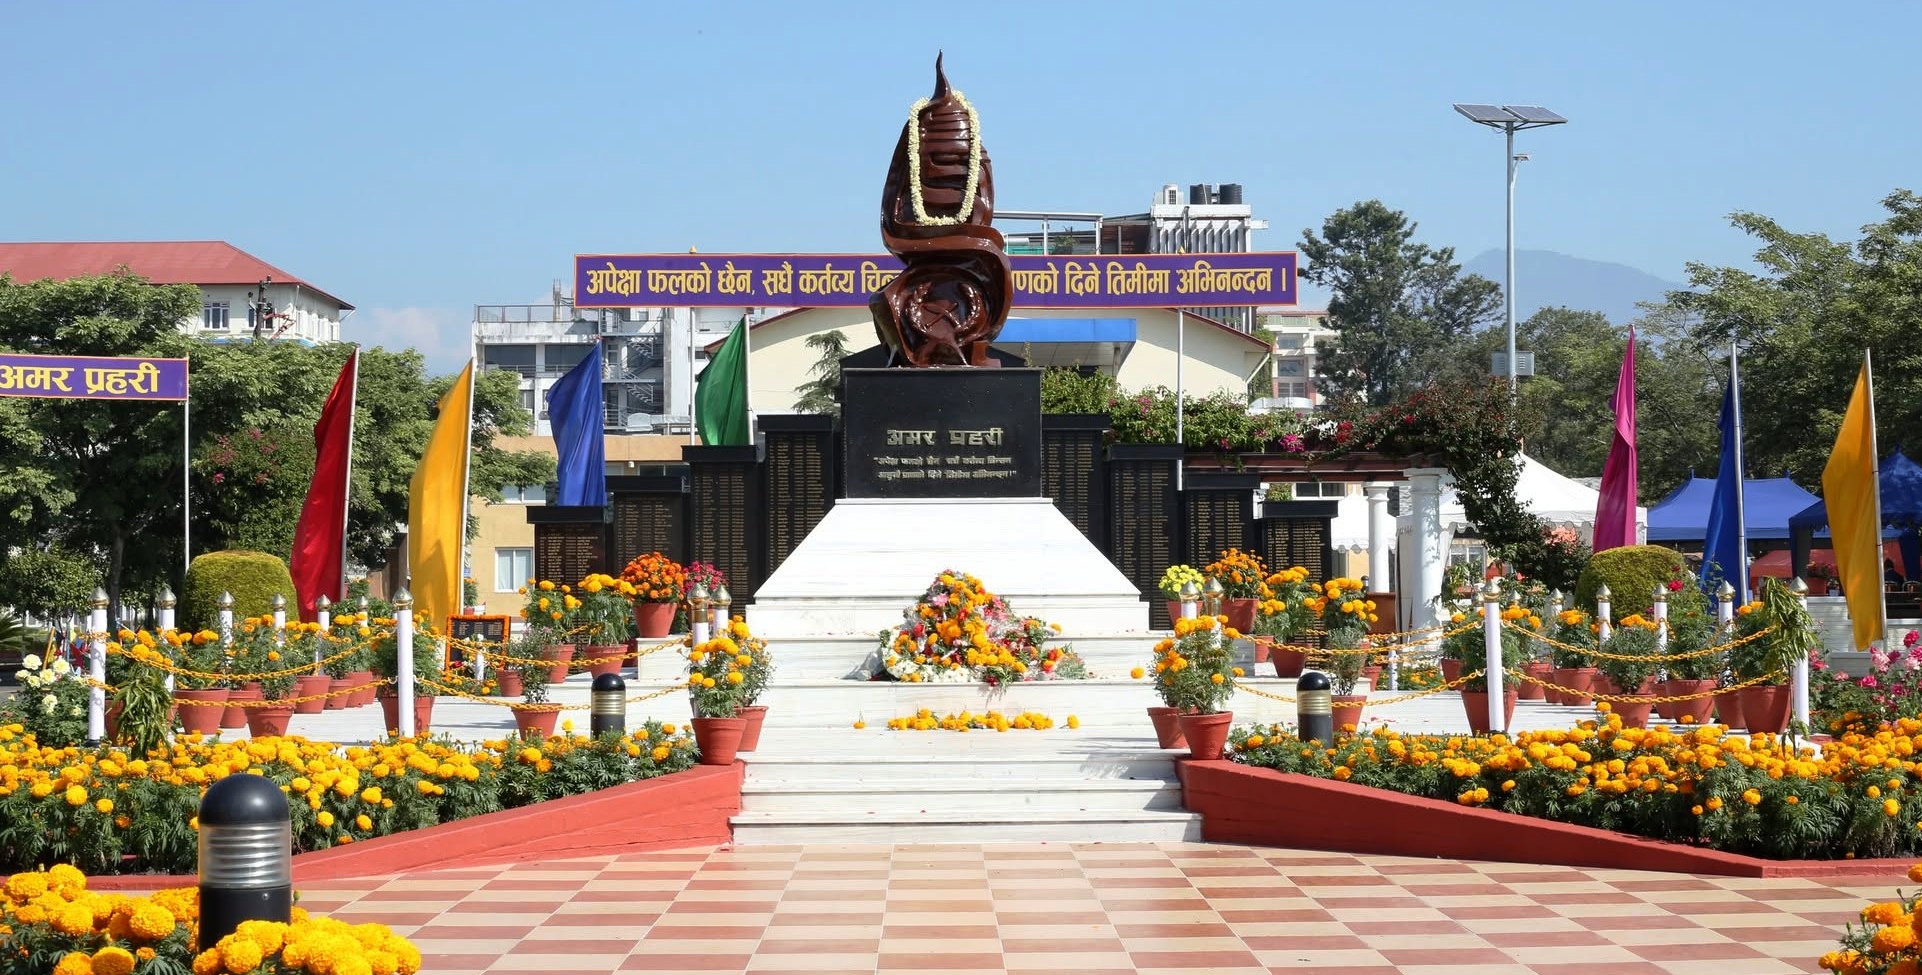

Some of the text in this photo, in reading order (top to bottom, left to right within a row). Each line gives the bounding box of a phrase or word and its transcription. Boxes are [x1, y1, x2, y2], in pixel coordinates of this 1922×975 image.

[586, 261, 642, 297] अपेक्षा
[647, 261, 713, 295] फलको
[717, 260, 755, 296] छैन,
[799, 263, 856, 295] कर्तव्य
[1064, 261, 1101, 296] दिने
[1106, 261, 1171, 296] तिमीमा
[1176, 259, 1273, 294] अभिनन्दन
[0, 361, 161, 395] अमर प्रहरी
[887, 427, 1004, 446] अमर प्रहरी
